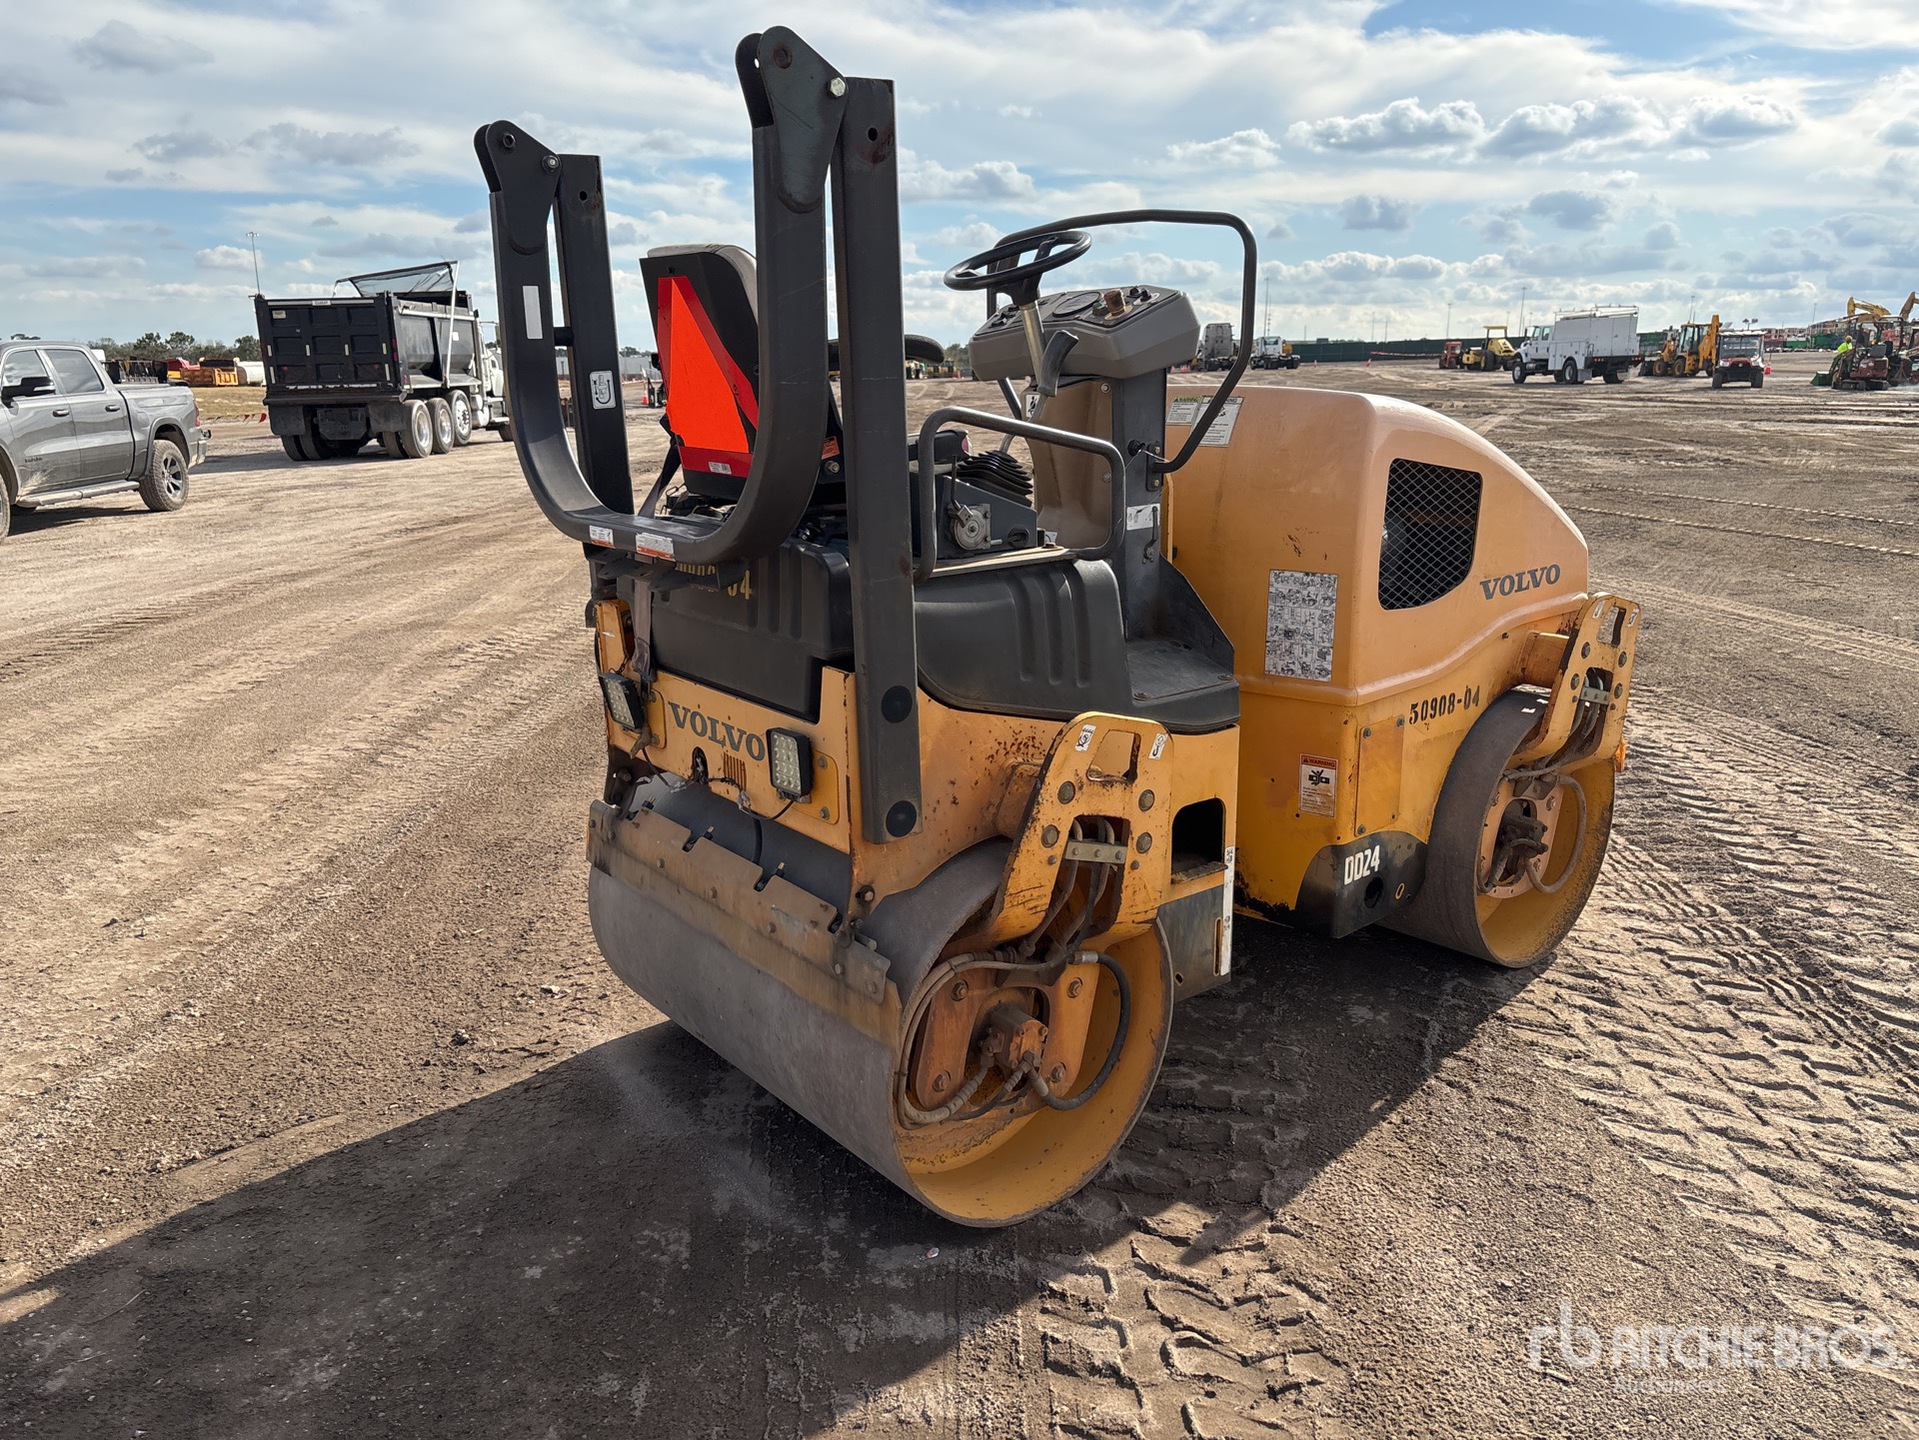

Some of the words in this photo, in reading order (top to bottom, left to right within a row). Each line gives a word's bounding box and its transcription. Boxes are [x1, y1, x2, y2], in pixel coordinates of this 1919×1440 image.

[1479, 563, 1561, 601] VOLVO
[1408, 684, 1481, 725] 50908-04
[667, 700, 766, 762] VOLVO
[1309, 758, 1336, 768] WARNING
[1343, 844, 1381, 886] DD24
